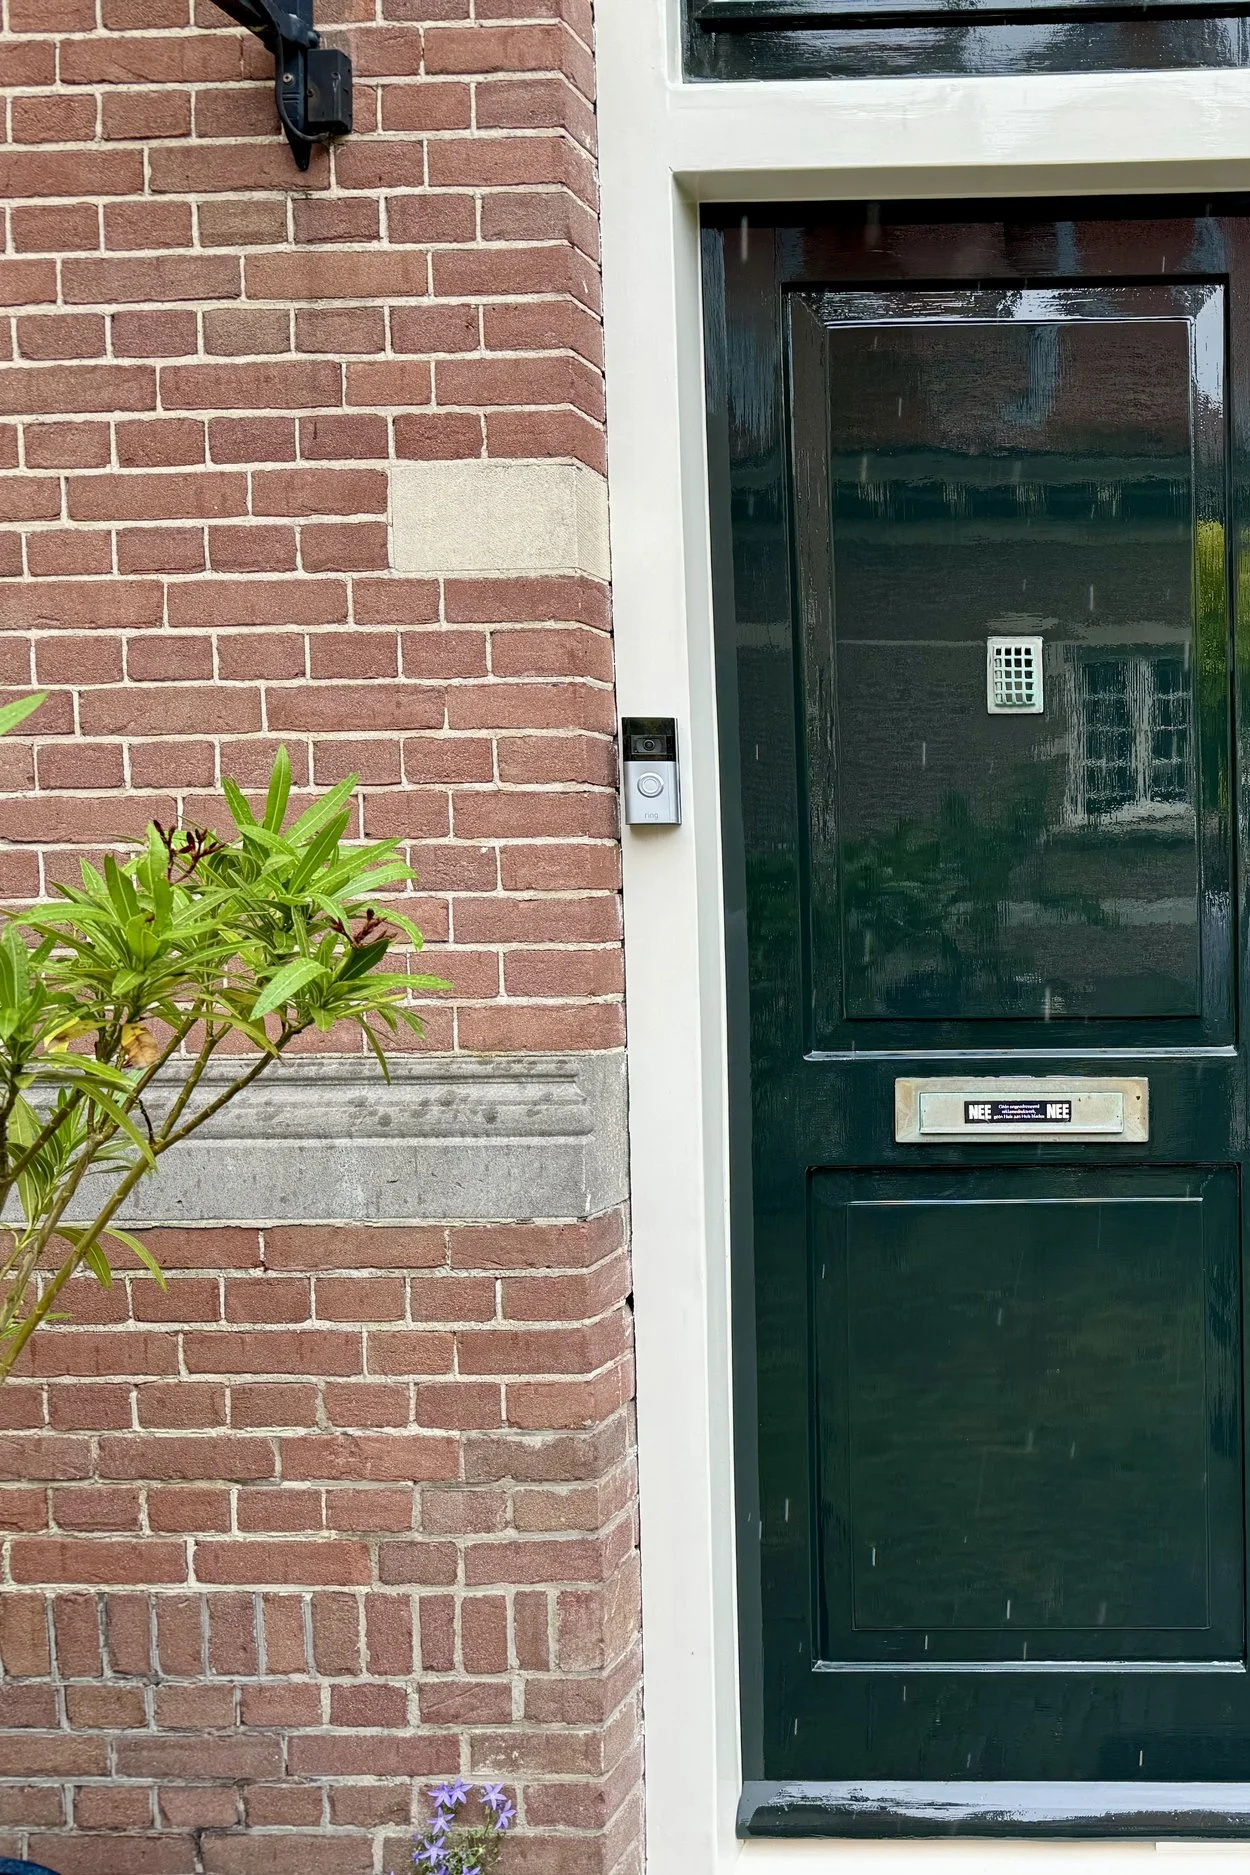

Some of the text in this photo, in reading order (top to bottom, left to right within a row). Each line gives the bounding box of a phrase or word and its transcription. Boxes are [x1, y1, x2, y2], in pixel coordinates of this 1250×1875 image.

[644, 812, 658, 820] ring
[968, 1104, 992, 1120] NEE
[1046, 1103, 1070, 1119] NEE
